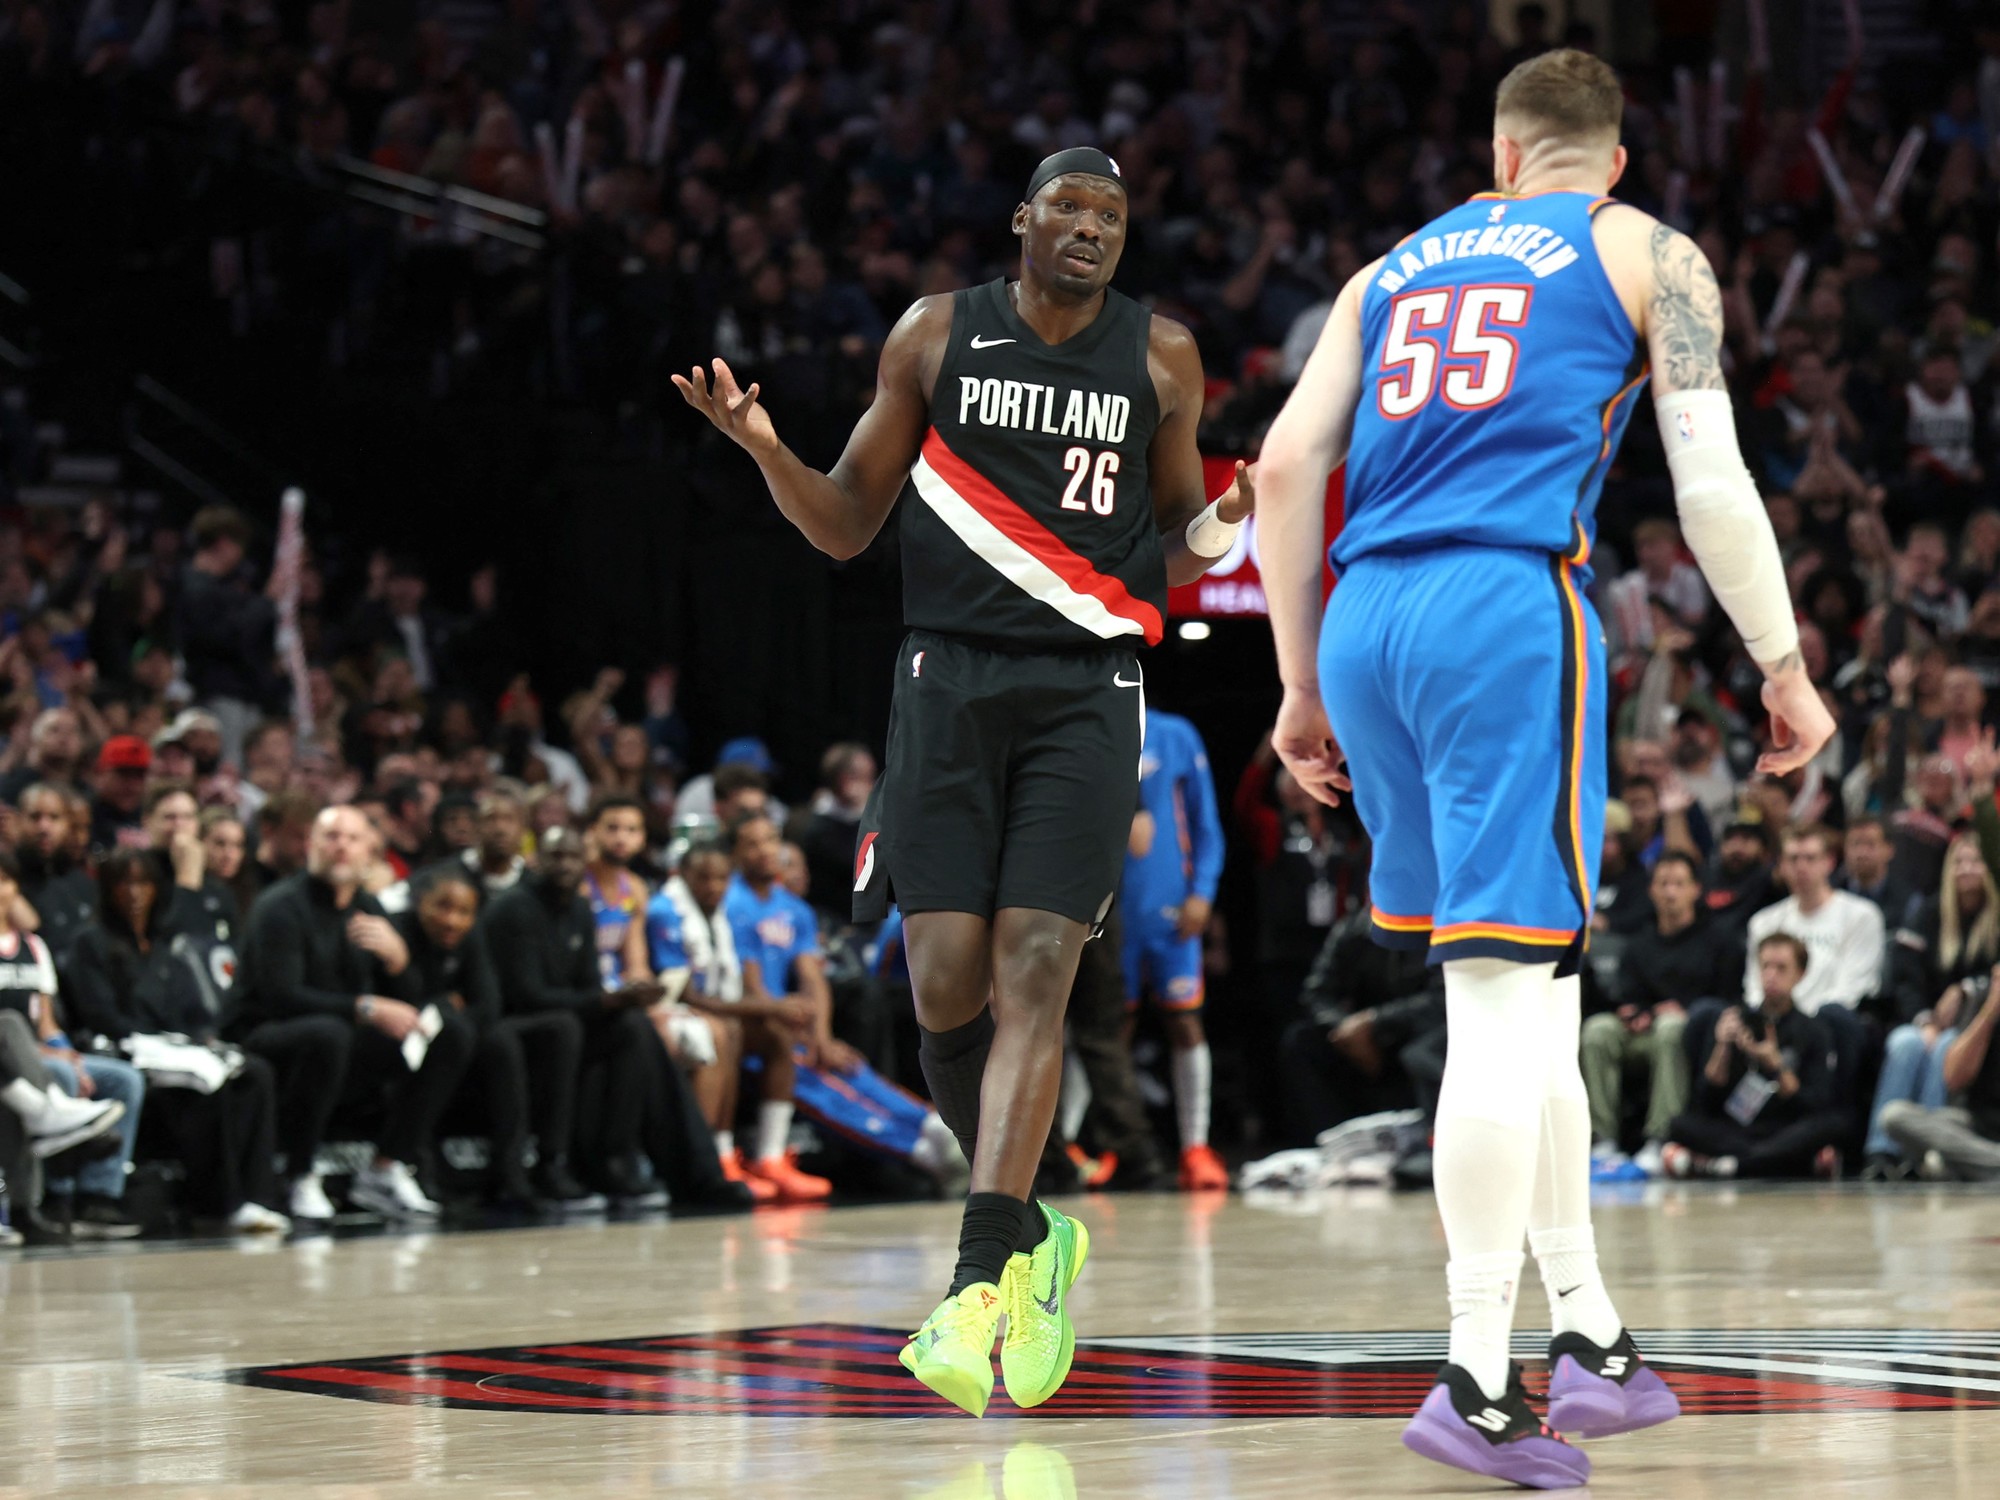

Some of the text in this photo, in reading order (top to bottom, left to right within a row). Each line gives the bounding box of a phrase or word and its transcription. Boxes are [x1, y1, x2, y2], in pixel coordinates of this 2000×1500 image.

[1377, 224, 1579, 294] HARTENSTEIN
[1378, 284, 1534, 421] 55
[959, 376, 1130, 443] PORTLAND
[1060, 446, 1120, 516] 26
